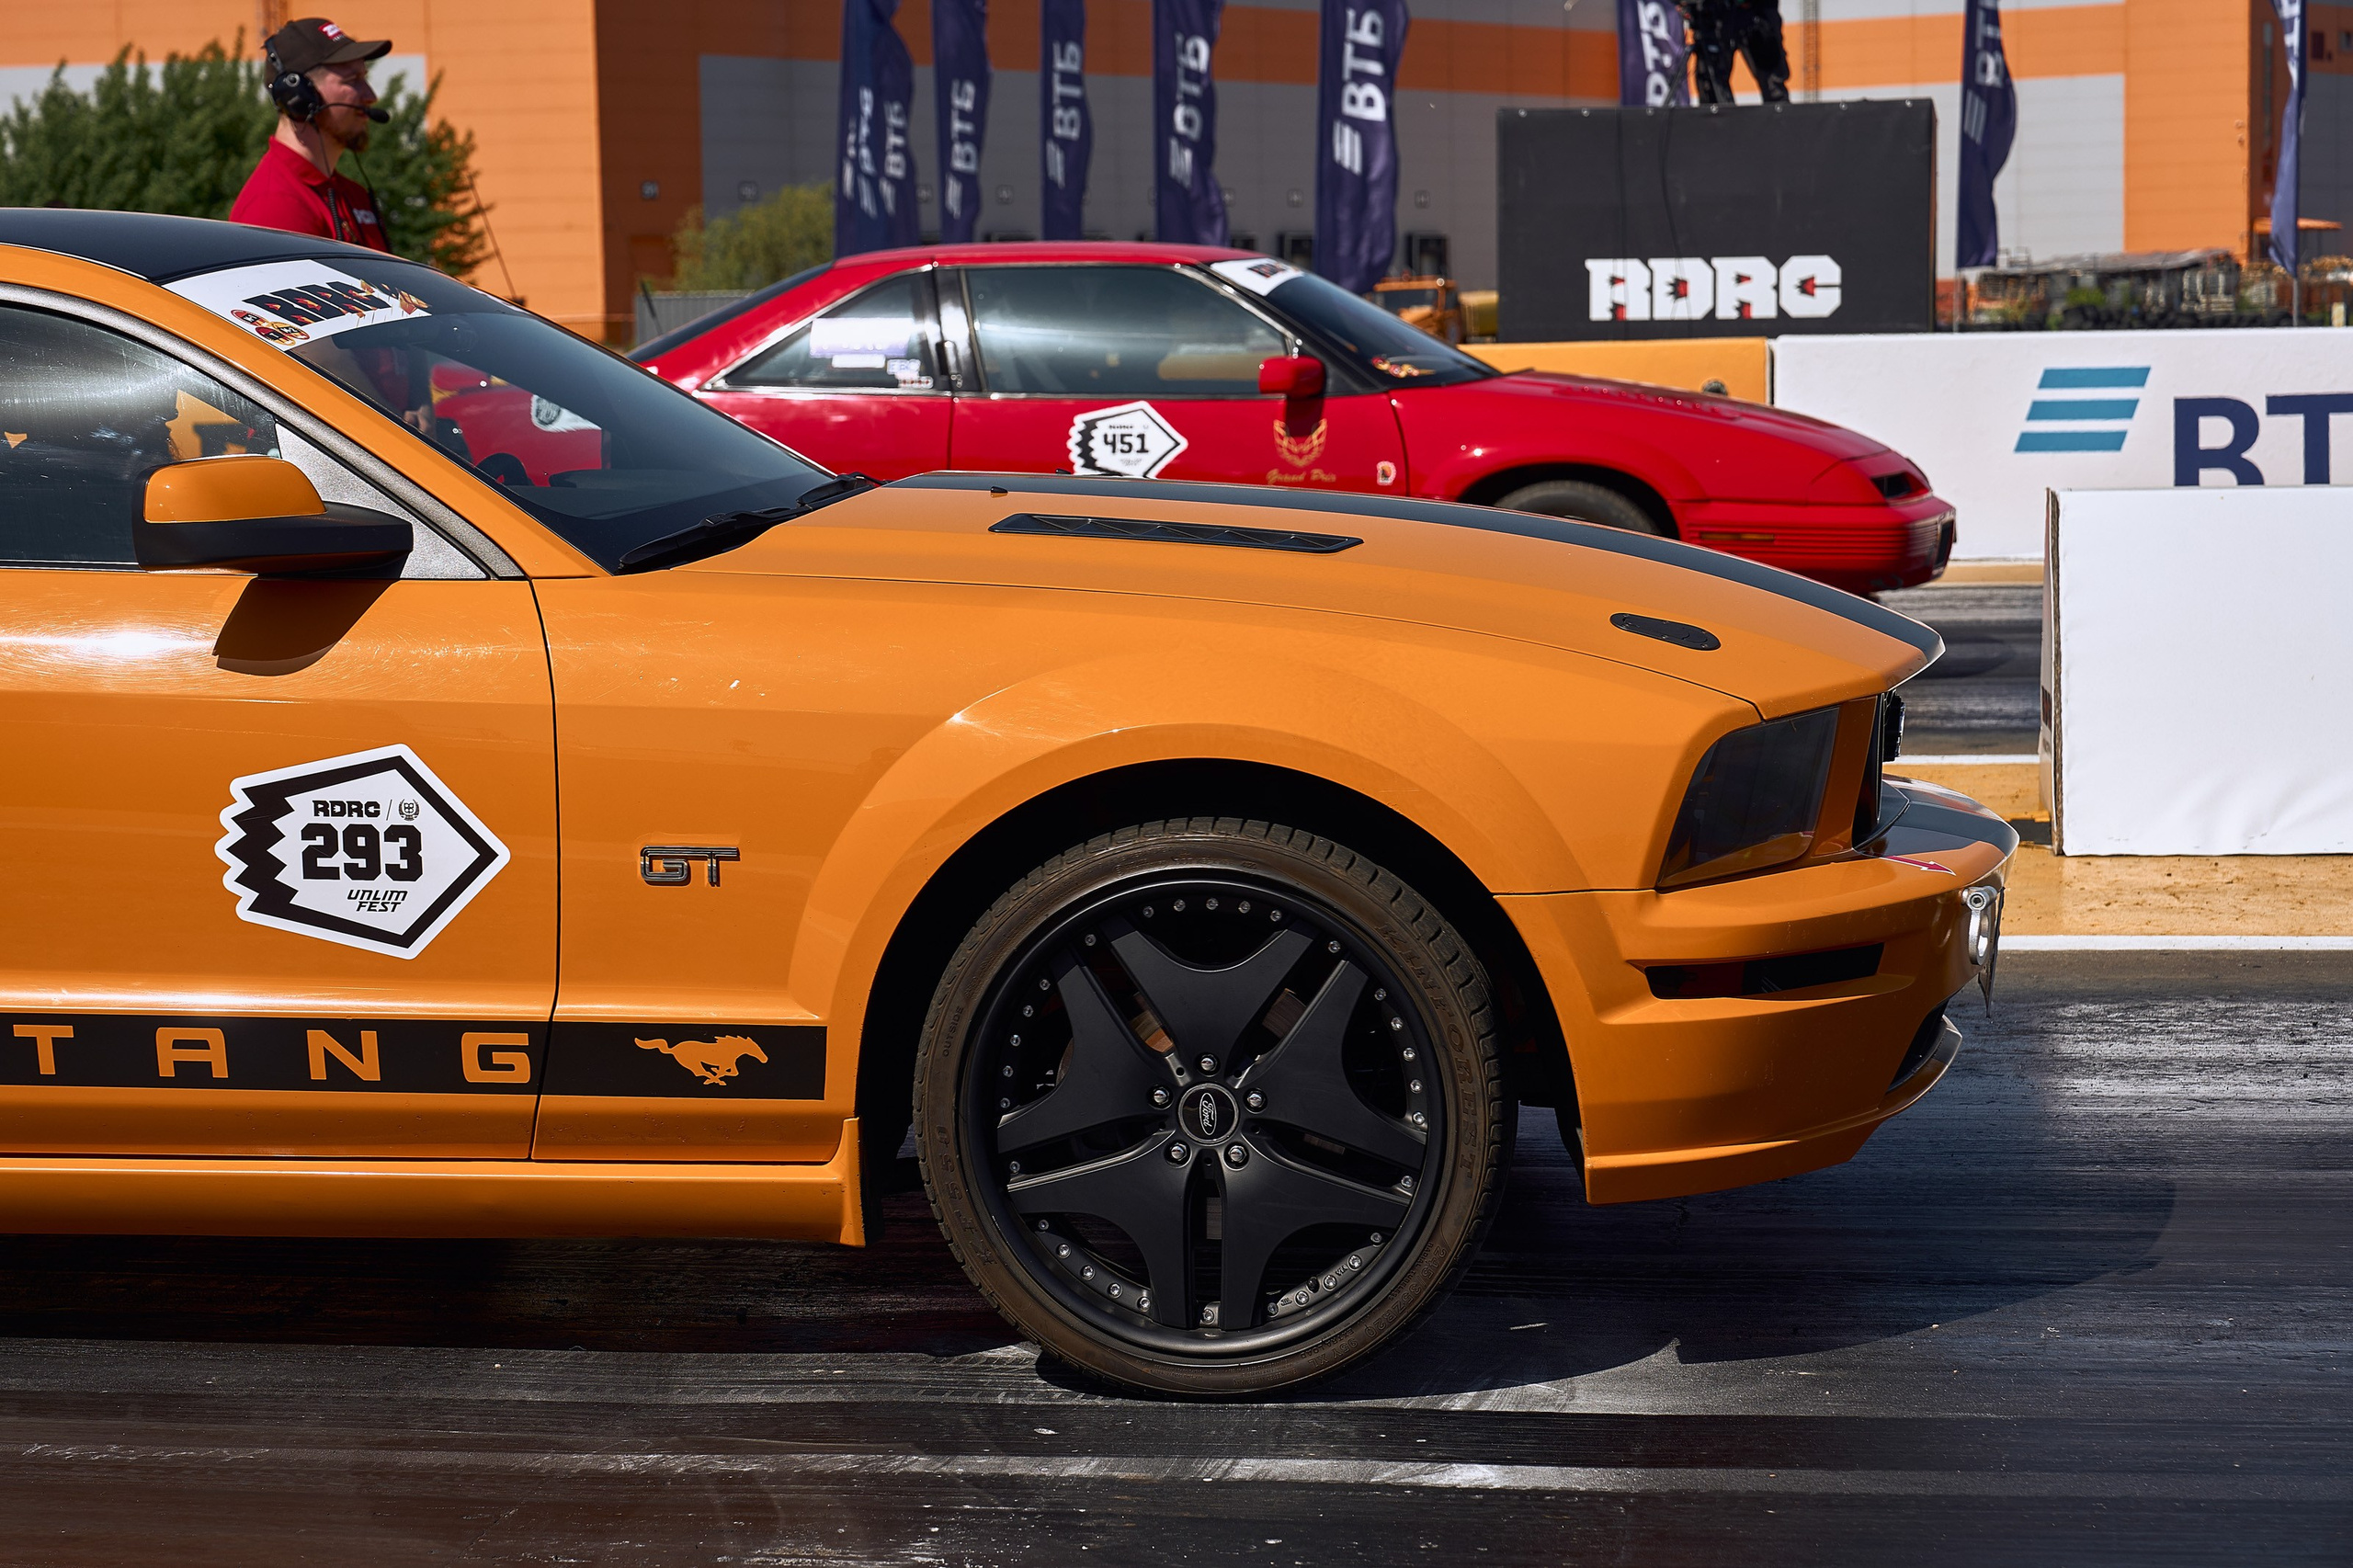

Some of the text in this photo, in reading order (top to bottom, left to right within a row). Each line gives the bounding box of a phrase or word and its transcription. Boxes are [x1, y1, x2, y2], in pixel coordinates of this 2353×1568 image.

[1341, 7, 1387, 122] ВТБ
[1975, 0, 2005, 88] ВТ
[1052, 40, 1083, 141] ВТБ
[883, 99, 906, 180] ВТБ
[950, 78, 978, 175] ВТБ
[1585, 255, 1842, 322] RDRC
[1104, 433, 1149, 454] 451
[313, 800, 381, 818] RDRC
[301, 823, 423, 882] 293
[640, 845, 739, 886] GT
[347, 889, 408, 902] UNLIM
[356, 901, 402, 913] FEST
[13, 1025, 531, 1085] TANG
[942, 1006, 964, 1057] OUTSIDE
[1202, 1100, 1214, 1128] Ford
[1364, 1245, 1448, 1338] 245/35ZR20
[1307, 1353, 1330, 1369] XL
[1334, 1336, 1359, 1359] 95Y
